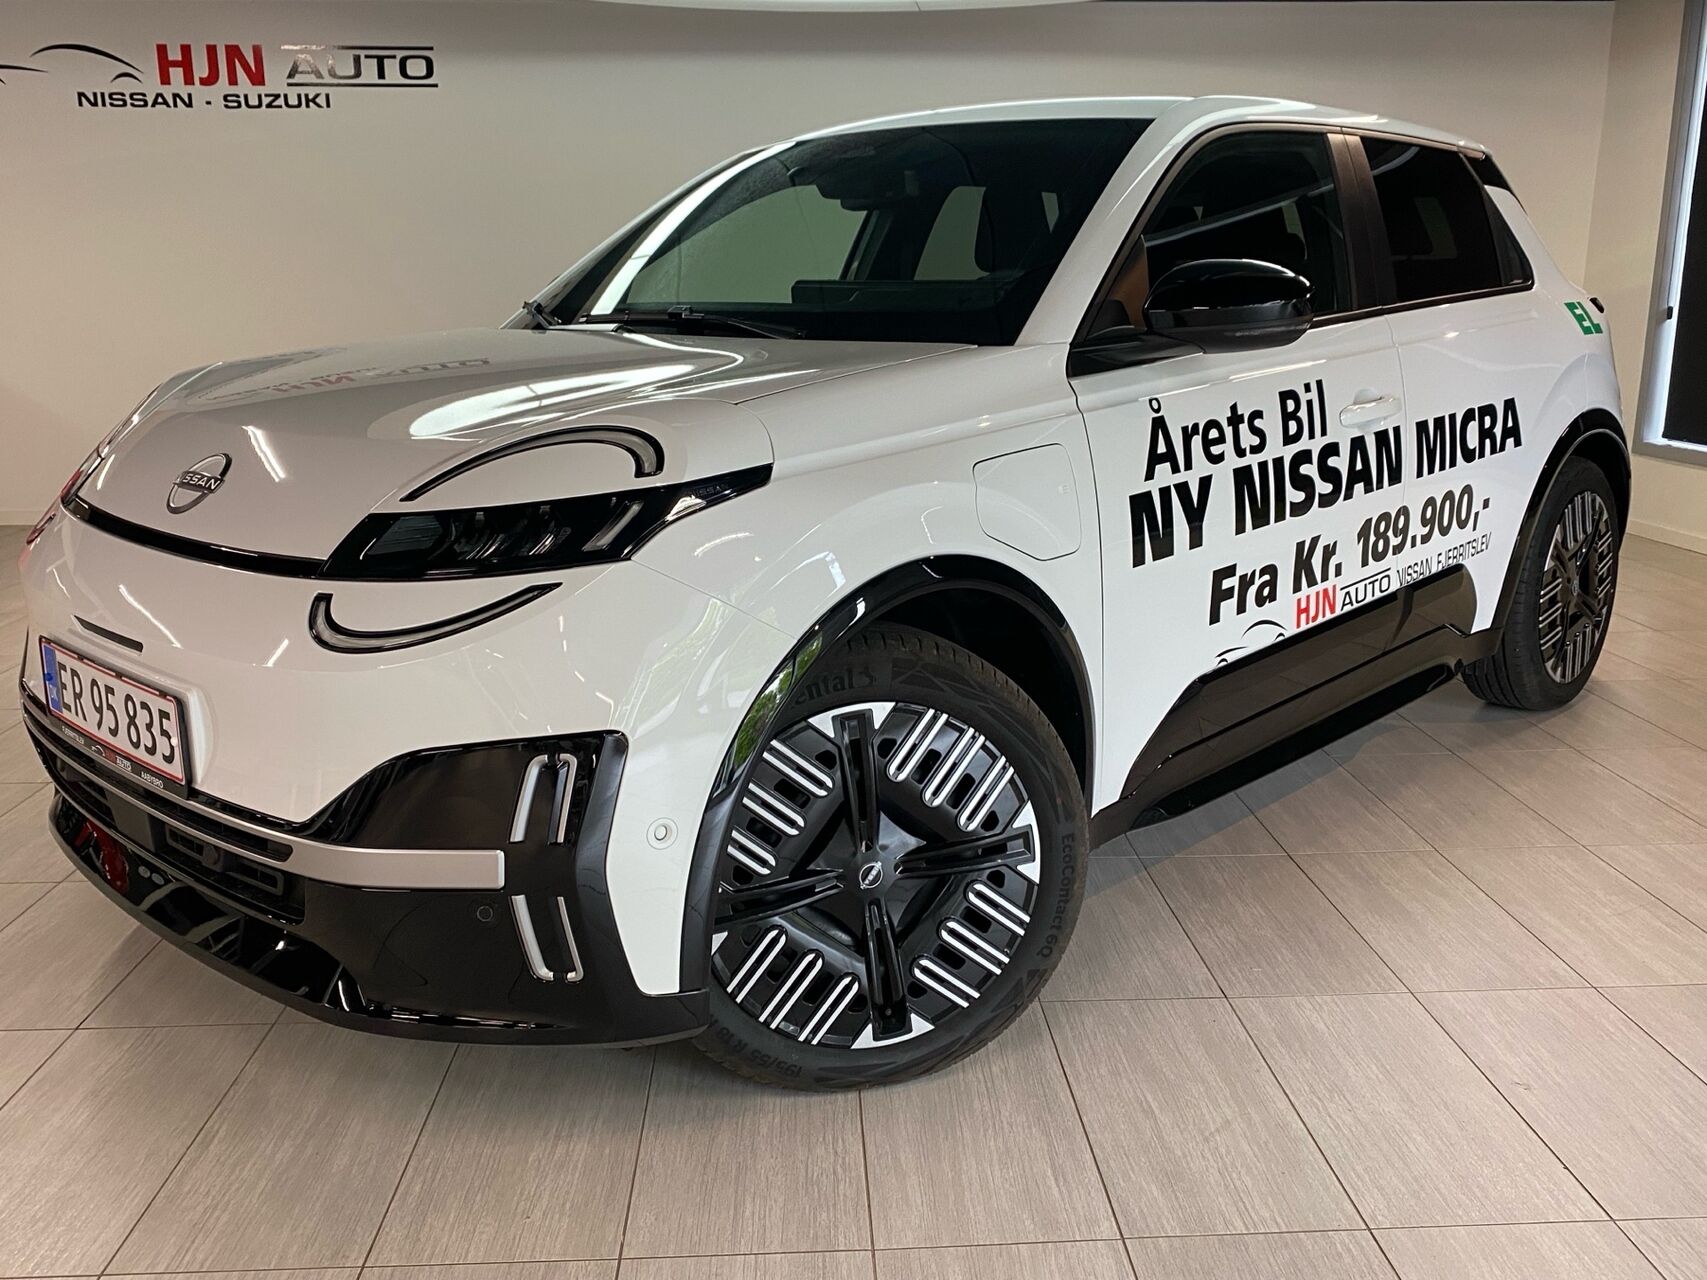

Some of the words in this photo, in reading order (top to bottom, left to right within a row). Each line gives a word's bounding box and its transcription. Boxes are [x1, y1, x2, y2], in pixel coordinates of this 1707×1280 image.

[77, 91, 194, 109] NISSAN
[223, 92, 332, 110] SUZUKI
[155, 43, 266, 87] HJN
[286, 53, 434, 81] AUTO
[1563, 301, 1603, 335] EL
[1144, 397, 1267, 482] Årets
[1278, 379, 1328, 448] Bil
[178, 472, 221, 490] SSAN
[1128, 473, 1213, 569] NY
[1233, 425, 1401, 536] NISSAN
[1415, 397, 1522, 479] MICRA
[1208, 561, 1279, 626] Fra
[1292, 534, 1343, 594] Kr.
[1357, 484, 1491, 568] 189.900,-
[1296, 584, 1337, 629] HJN
[1340, 577, 1391, 612] AUTO
[57, 661, 88, 722] ER
[90, 678, 119, 738] 95
[124, 693, 175, 764] 835
[1050, 832, 1075, 930] EcoContact
